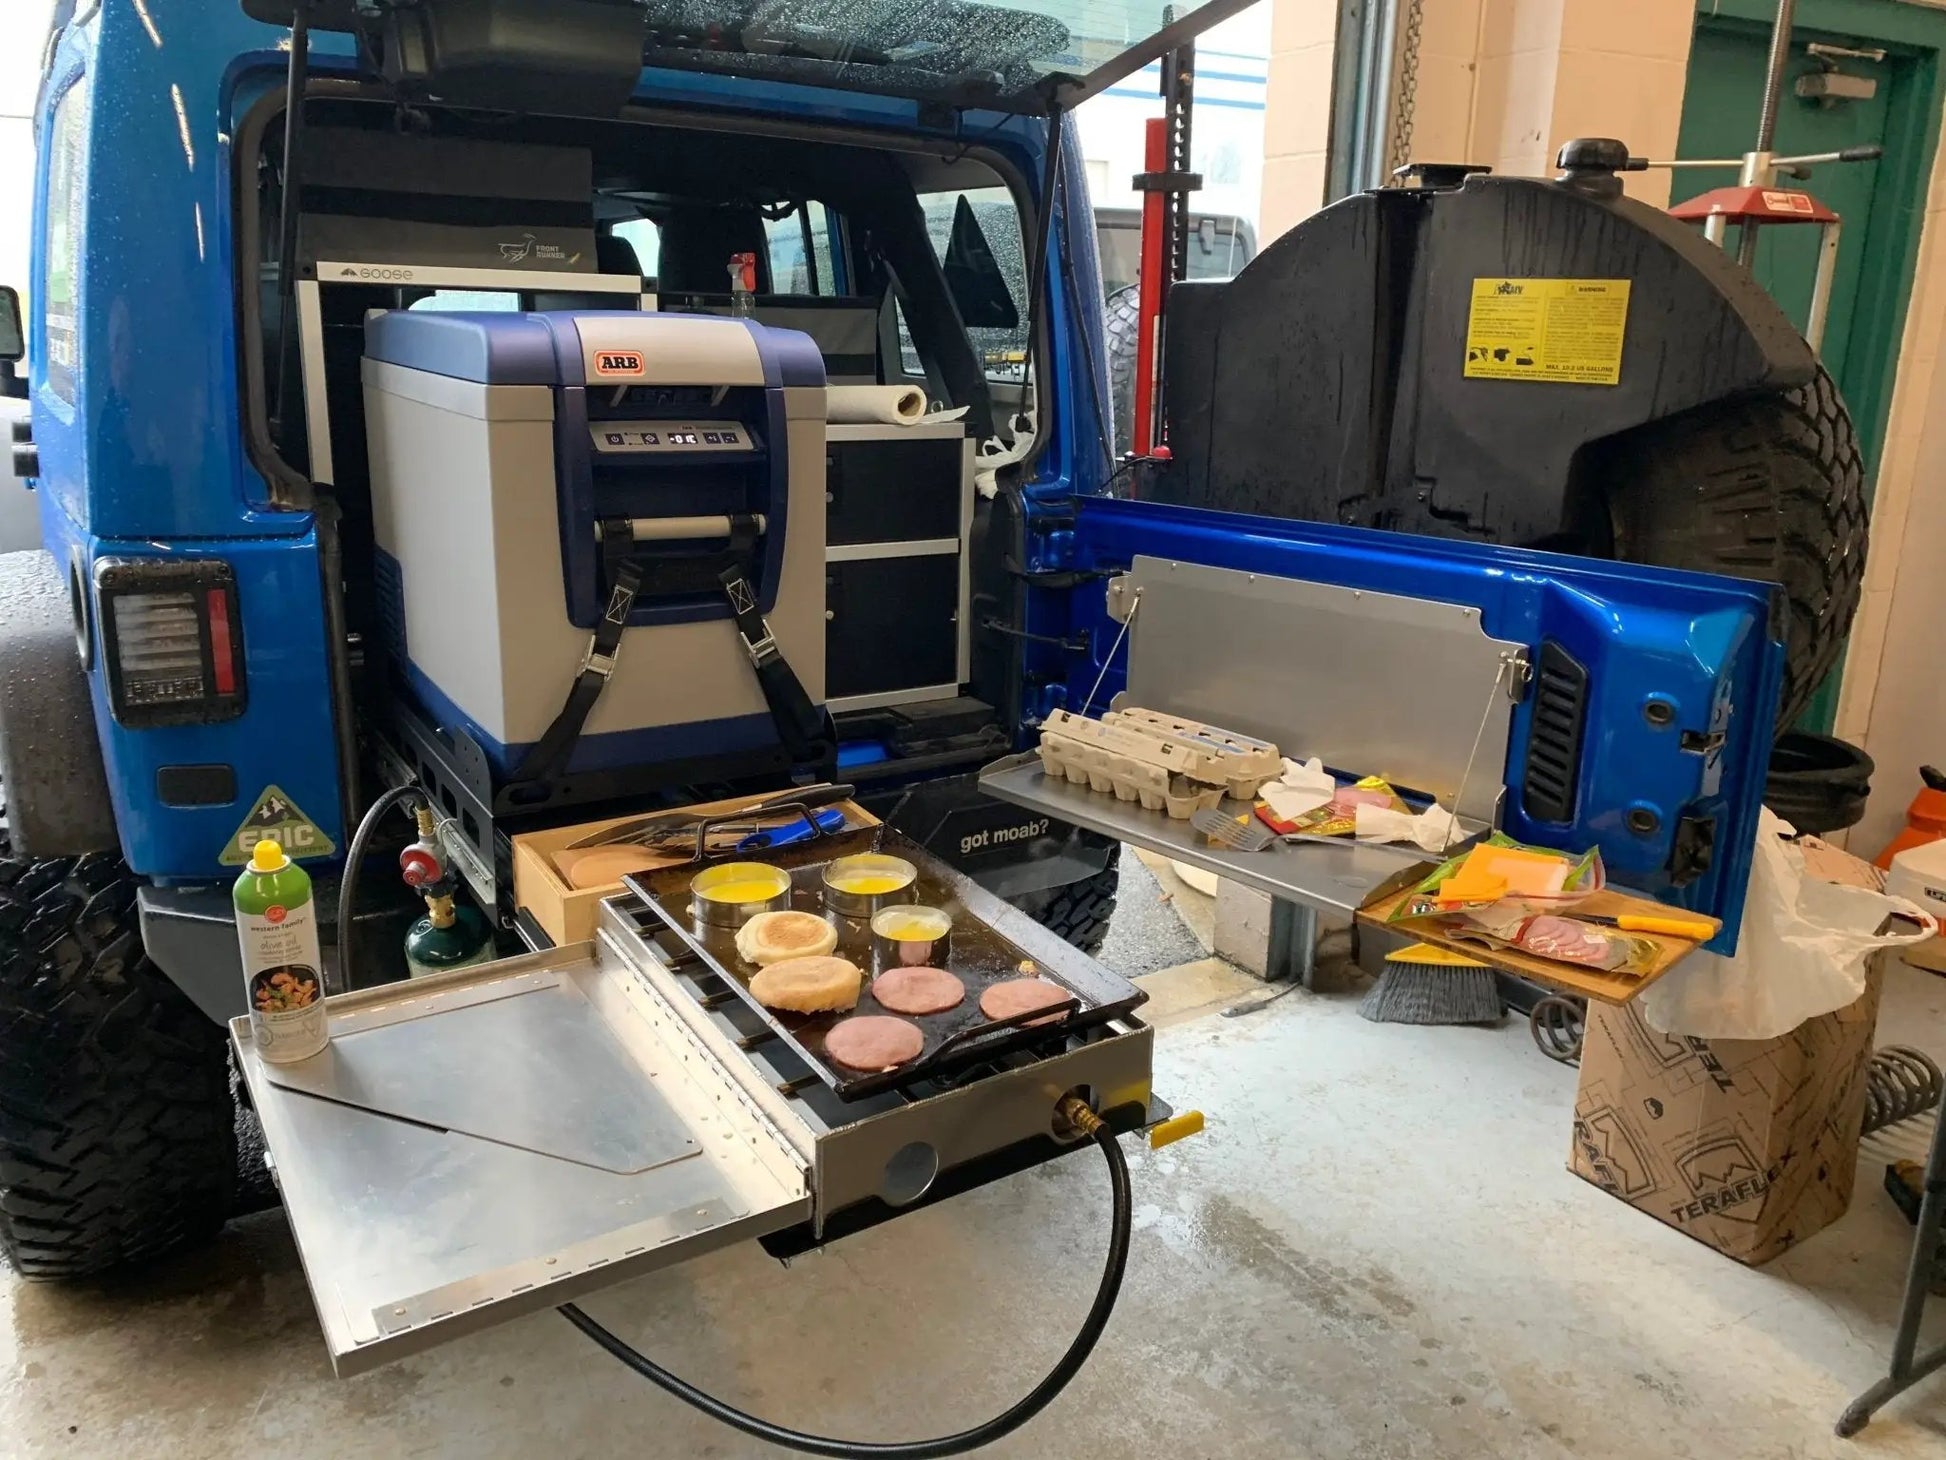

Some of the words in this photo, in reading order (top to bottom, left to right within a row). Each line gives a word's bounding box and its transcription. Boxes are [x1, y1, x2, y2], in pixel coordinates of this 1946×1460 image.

[601, 356, 639, 369] ARB
[960, 830, 989, 854] got
[994, 819, 1050, 843] moab?
[281, 918, 304, 930] family
[1670, 1144, 1799, 1222] TERAFLEX
